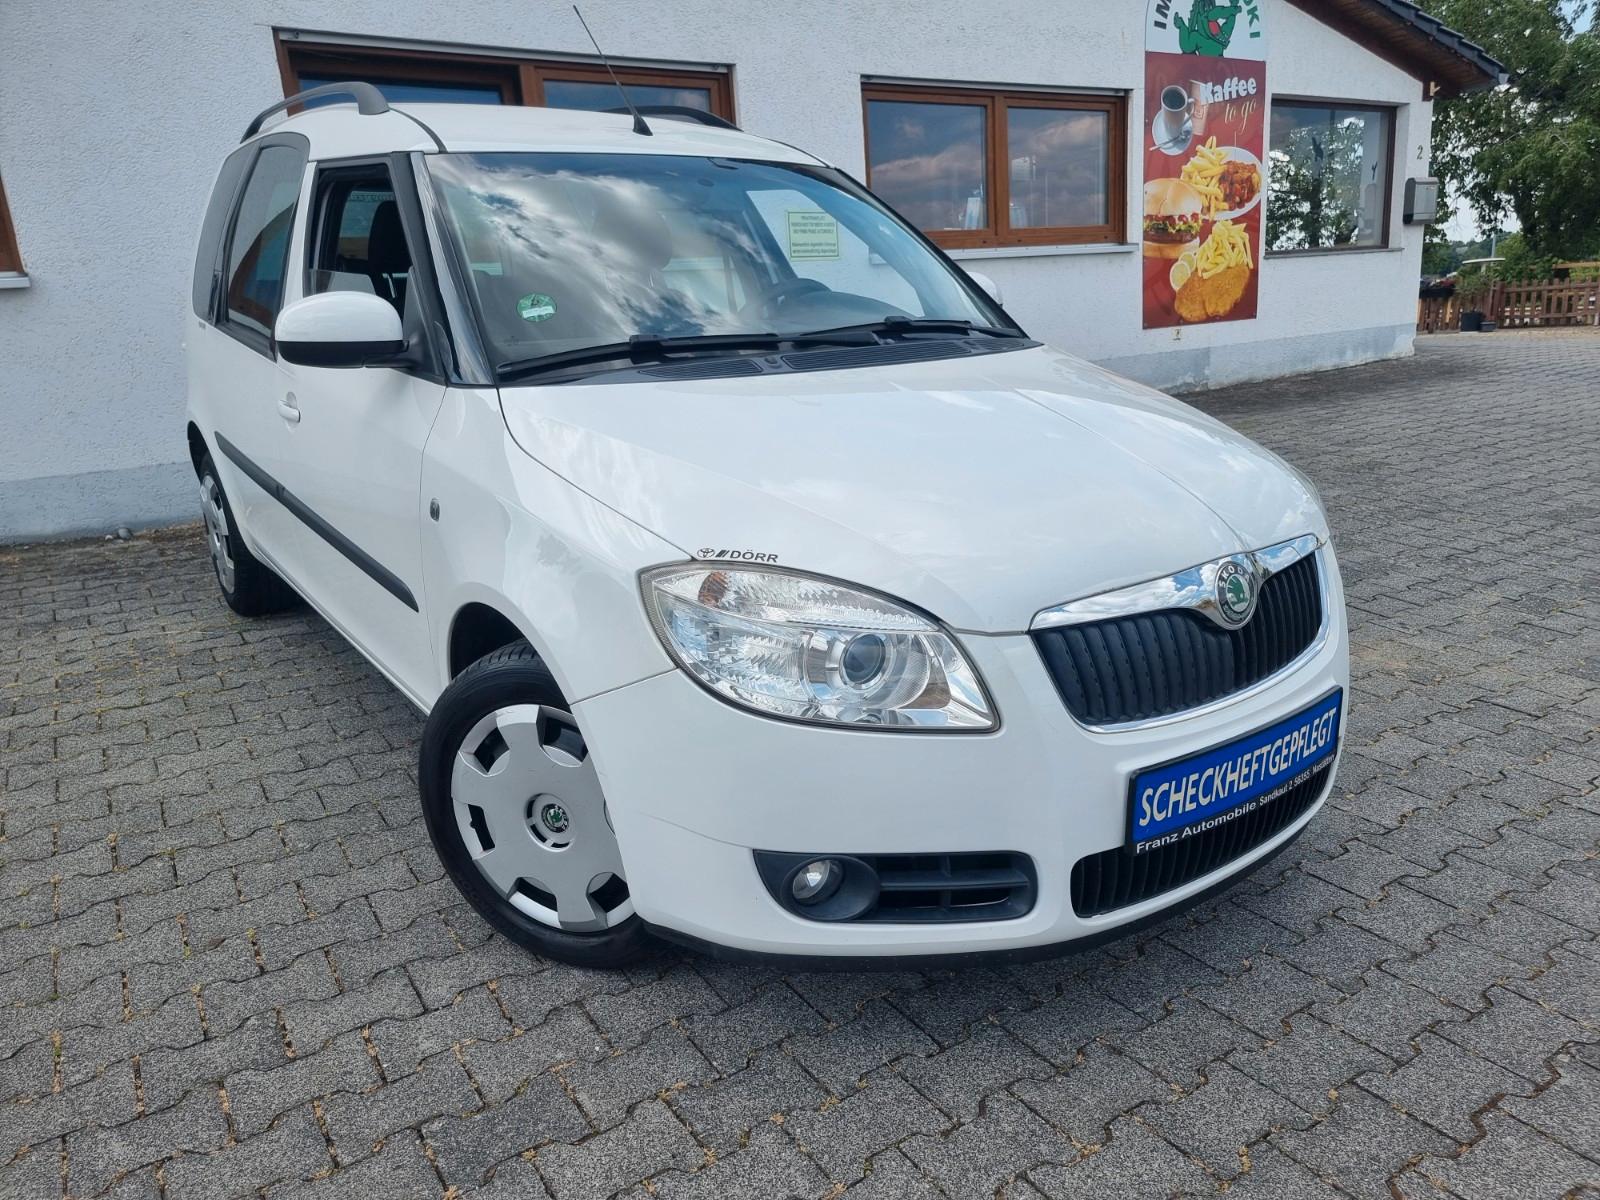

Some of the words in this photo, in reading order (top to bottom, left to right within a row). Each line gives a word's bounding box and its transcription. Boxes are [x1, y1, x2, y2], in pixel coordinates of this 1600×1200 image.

[1200, 77, 1257, 105] Kaffee
[1225, 103, 1236, 124] to
[1241, 99, 1257, 133] go
[1416, 145, 1424, 160] 2
[730, 549, 778, 563] DÖRR
[1139, 707, 1336, 826] SCHECKHEFTGEPFLEGT
[1136, 832, 1178, 854] Franz
[1181, 801, 1256, 838] Automobile
